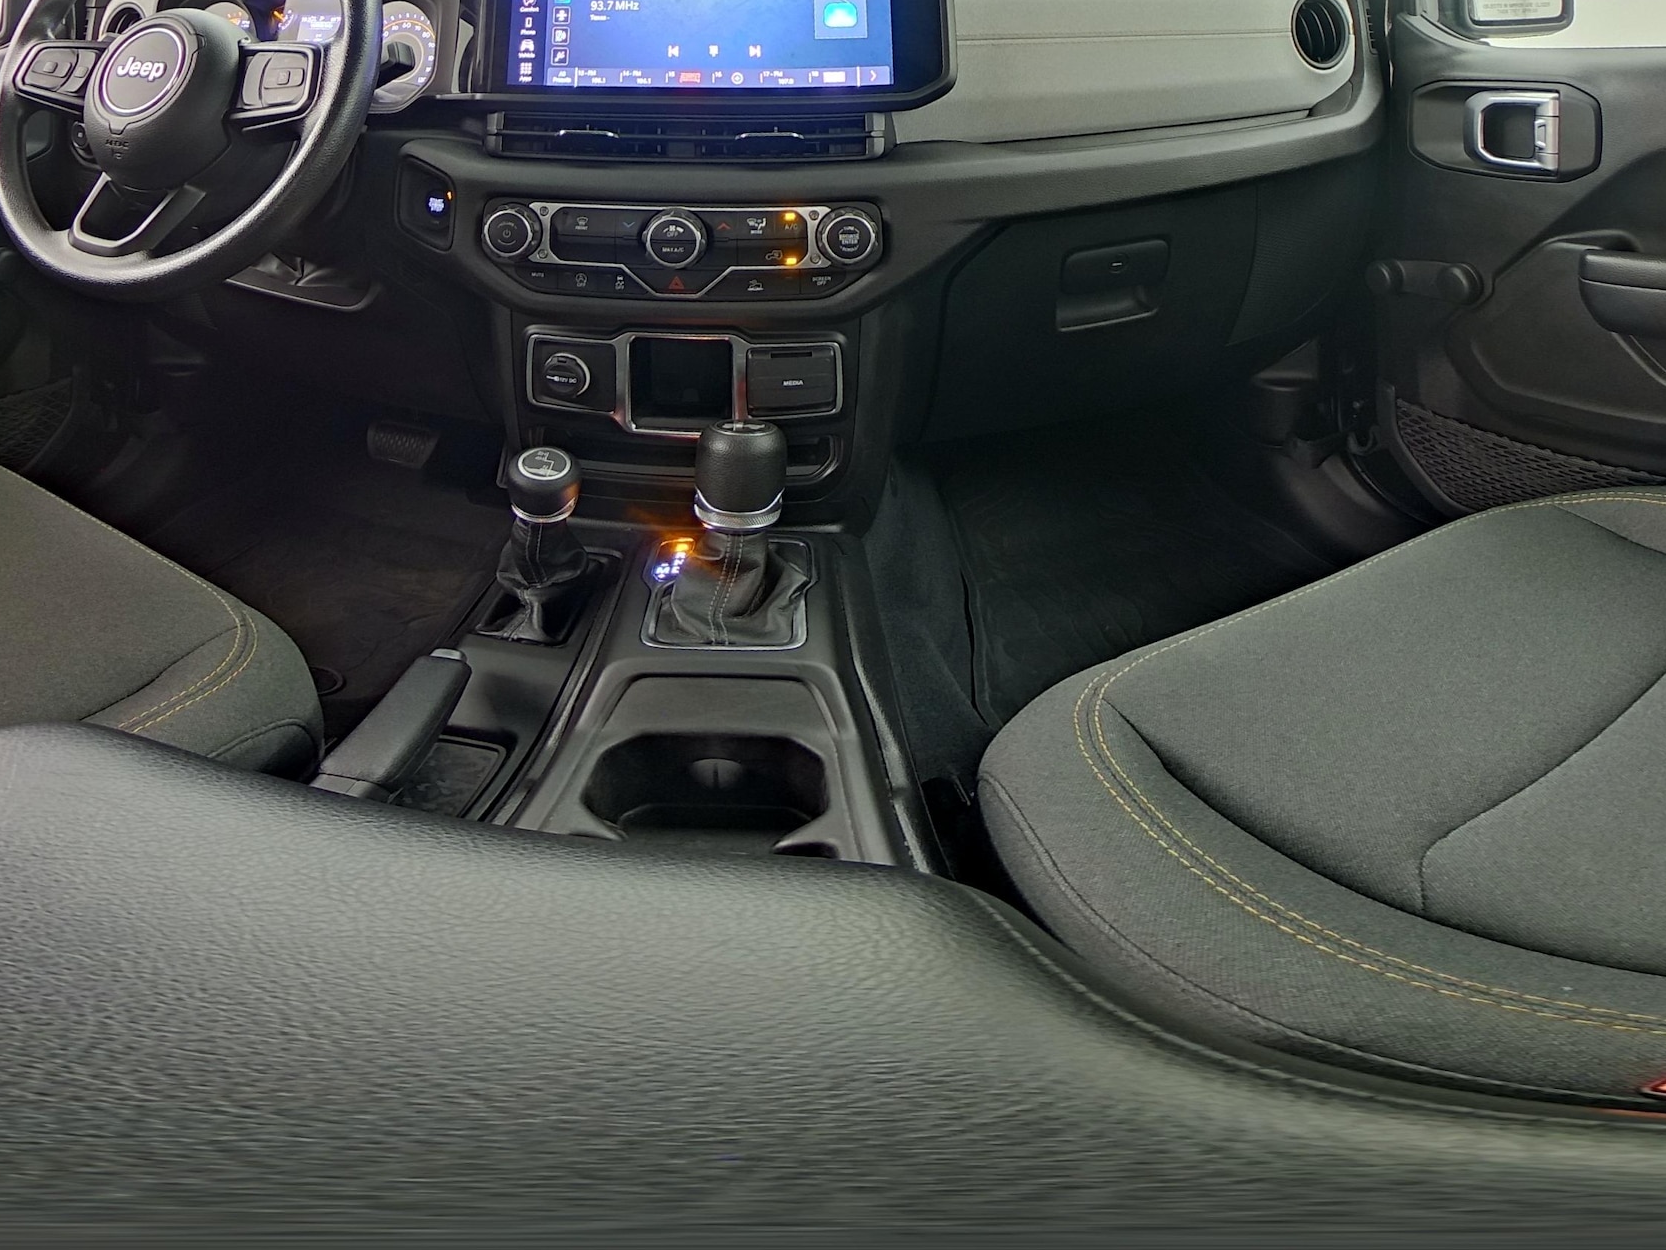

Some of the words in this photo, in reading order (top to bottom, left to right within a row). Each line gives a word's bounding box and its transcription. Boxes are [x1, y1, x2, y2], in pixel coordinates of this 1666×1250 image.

[590, 1, 613, 11] 93.7
[615, 0, 639, 11] MHz
[117, 56, 166, 82] Jeep
